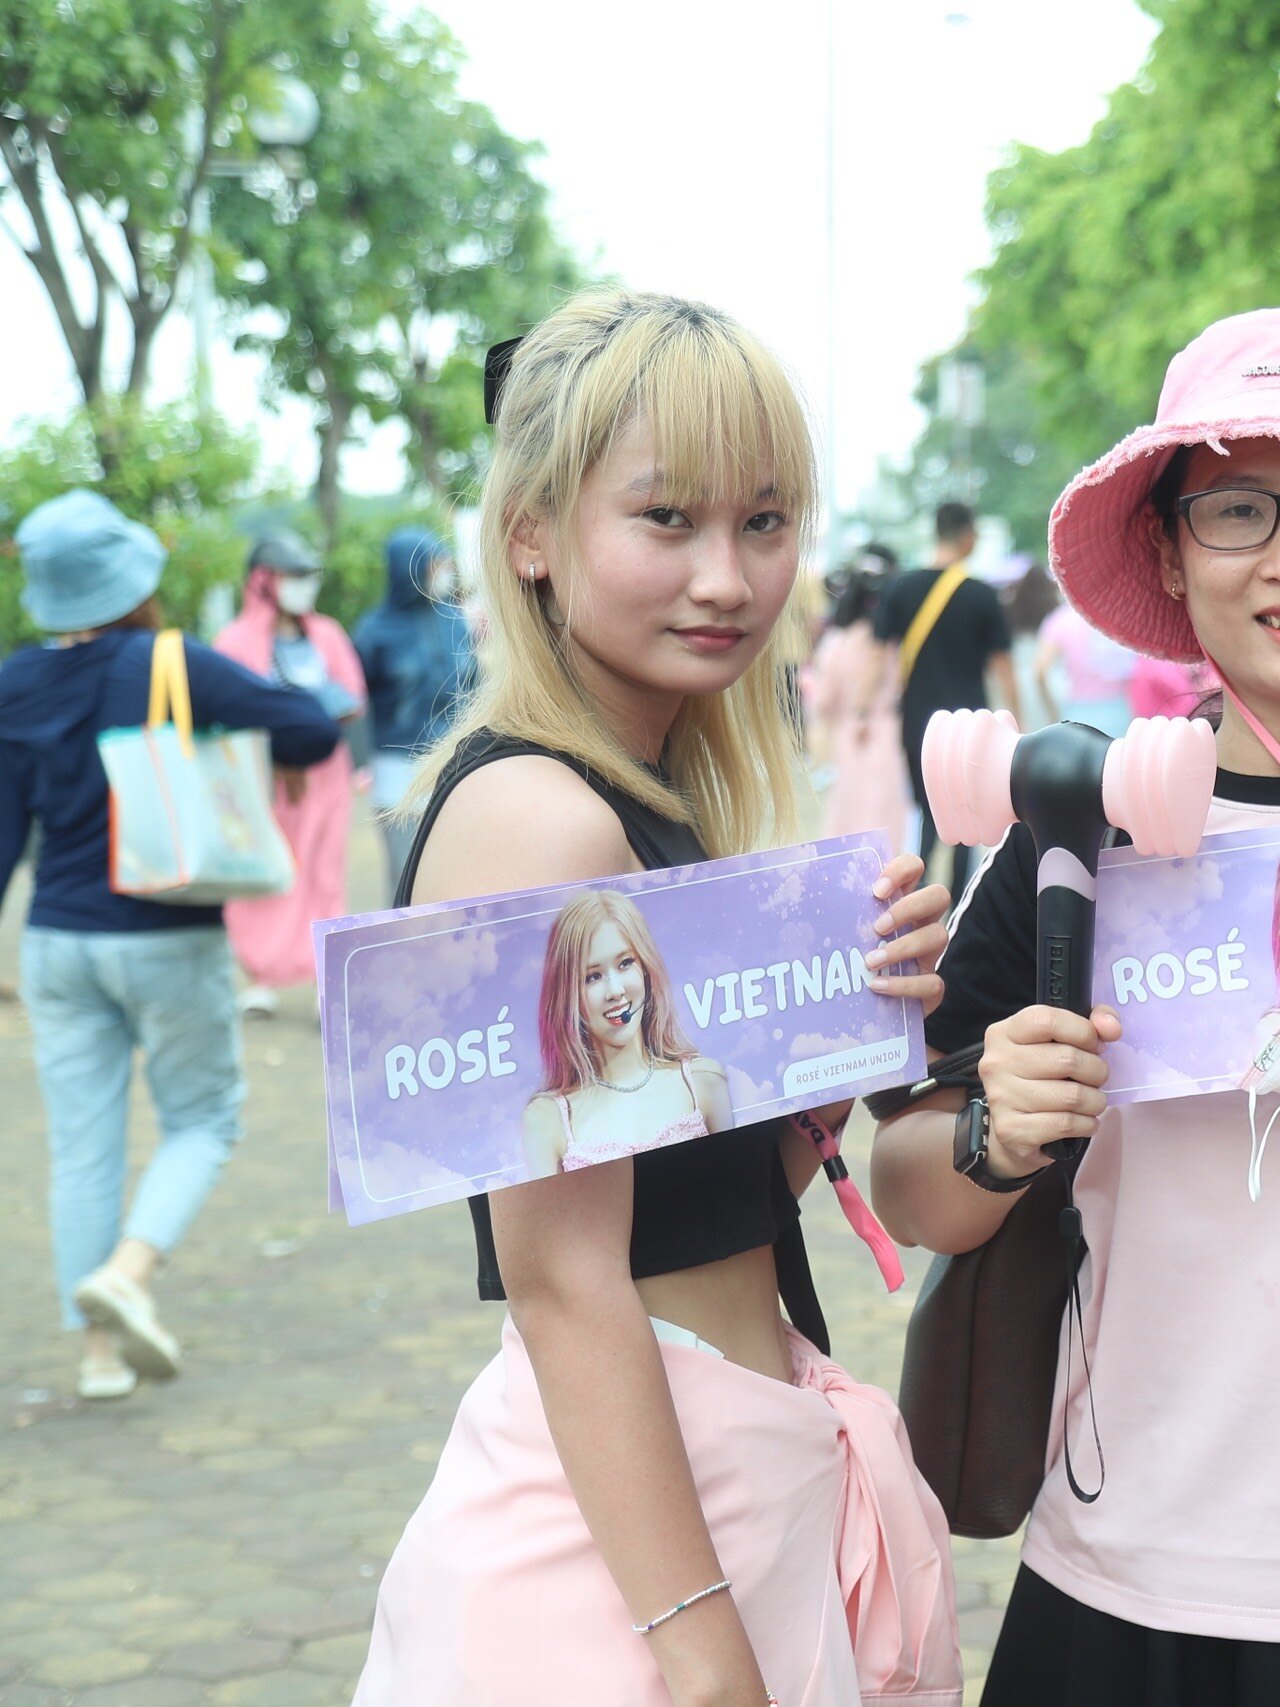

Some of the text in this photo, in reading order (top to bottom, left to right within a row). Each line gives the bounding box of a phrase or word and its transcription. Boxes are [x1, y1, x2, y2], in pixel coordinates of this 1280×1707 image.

[1111, 926, 1249, 1004] ROSÉ
[384, 1006, 517, 1099] ROSÉ
[796, 1049, 901, 1085] ROSÉ VIETNAM UNION
